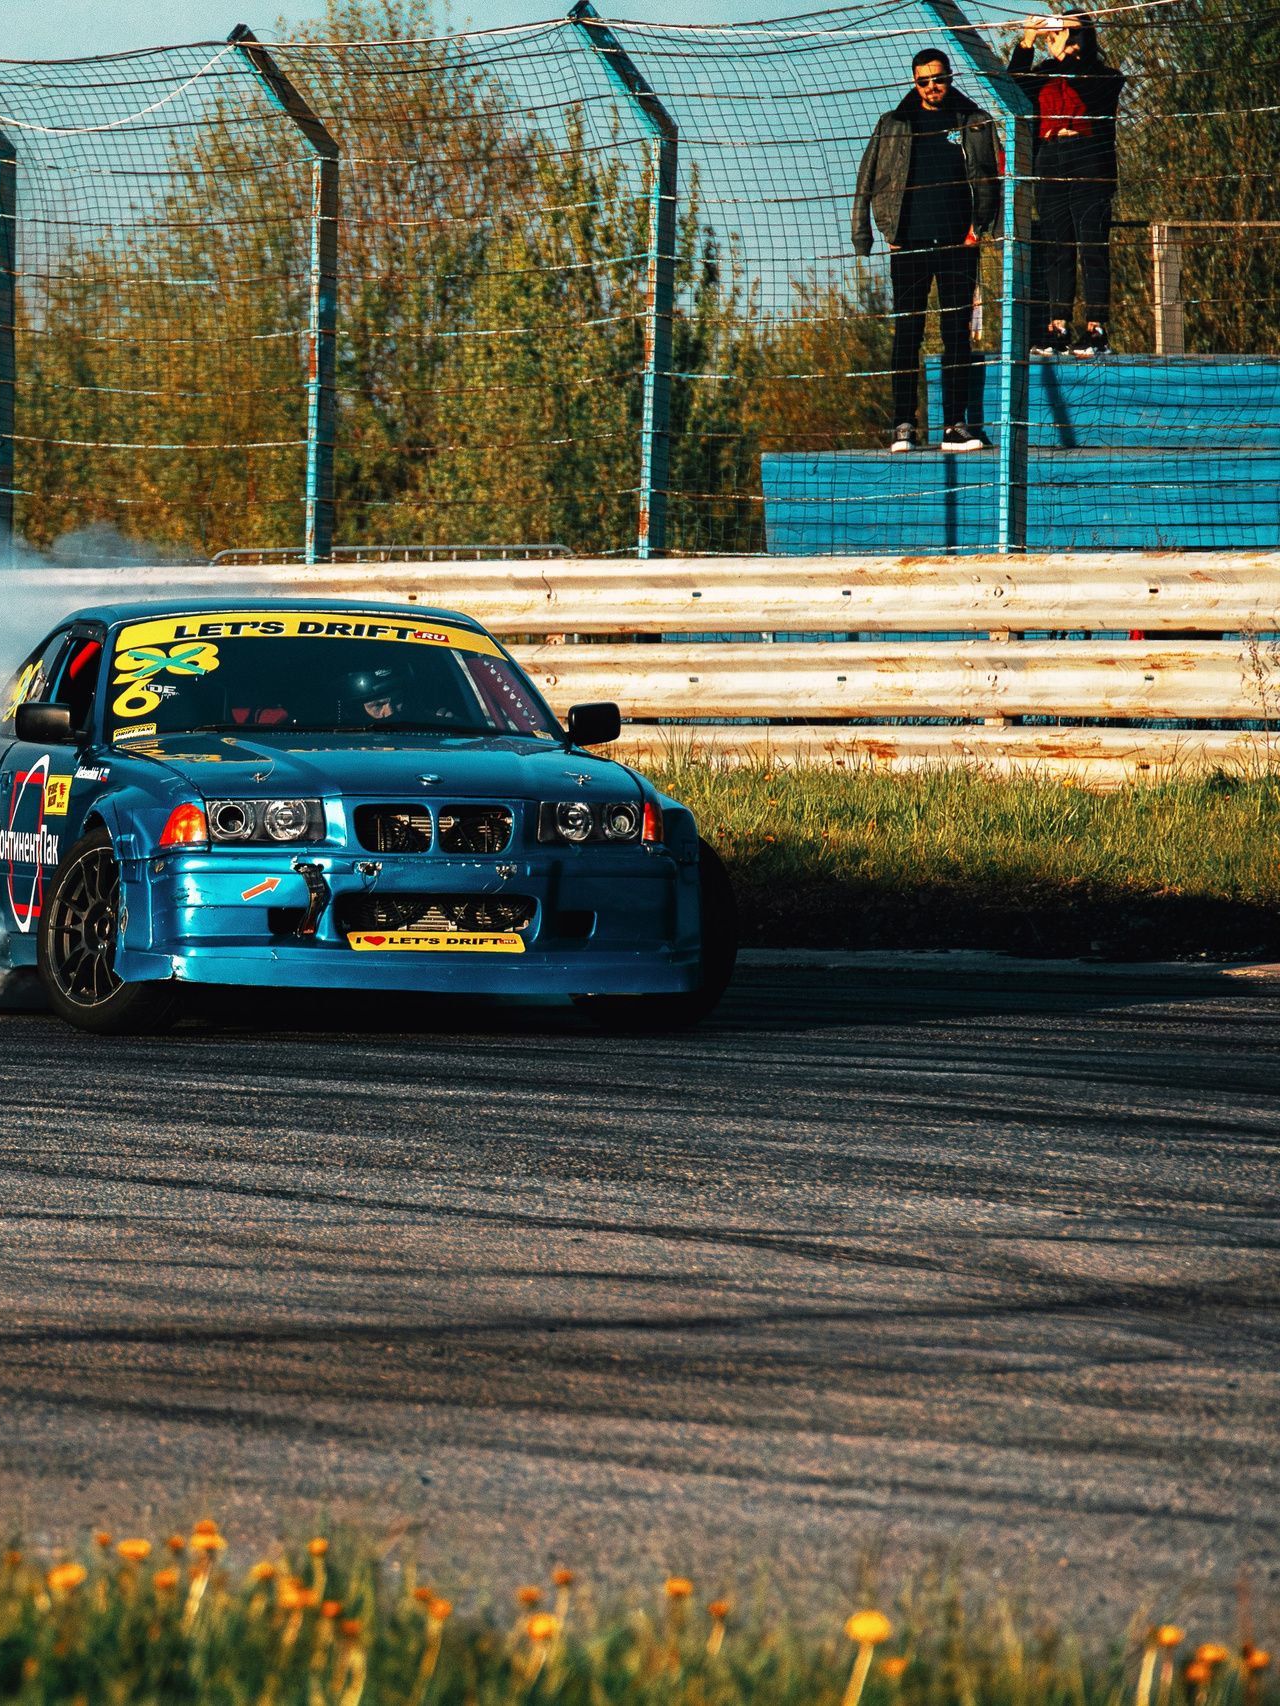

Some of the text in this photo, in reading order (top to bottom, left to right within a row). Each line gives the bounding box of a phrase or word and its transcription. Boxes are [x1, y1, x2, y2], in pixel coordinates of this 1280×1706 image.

[174, 621, 286, 639] LET'S
[112, 678, 160, 717] 6
[388, 937, 440, 945] LET'S
